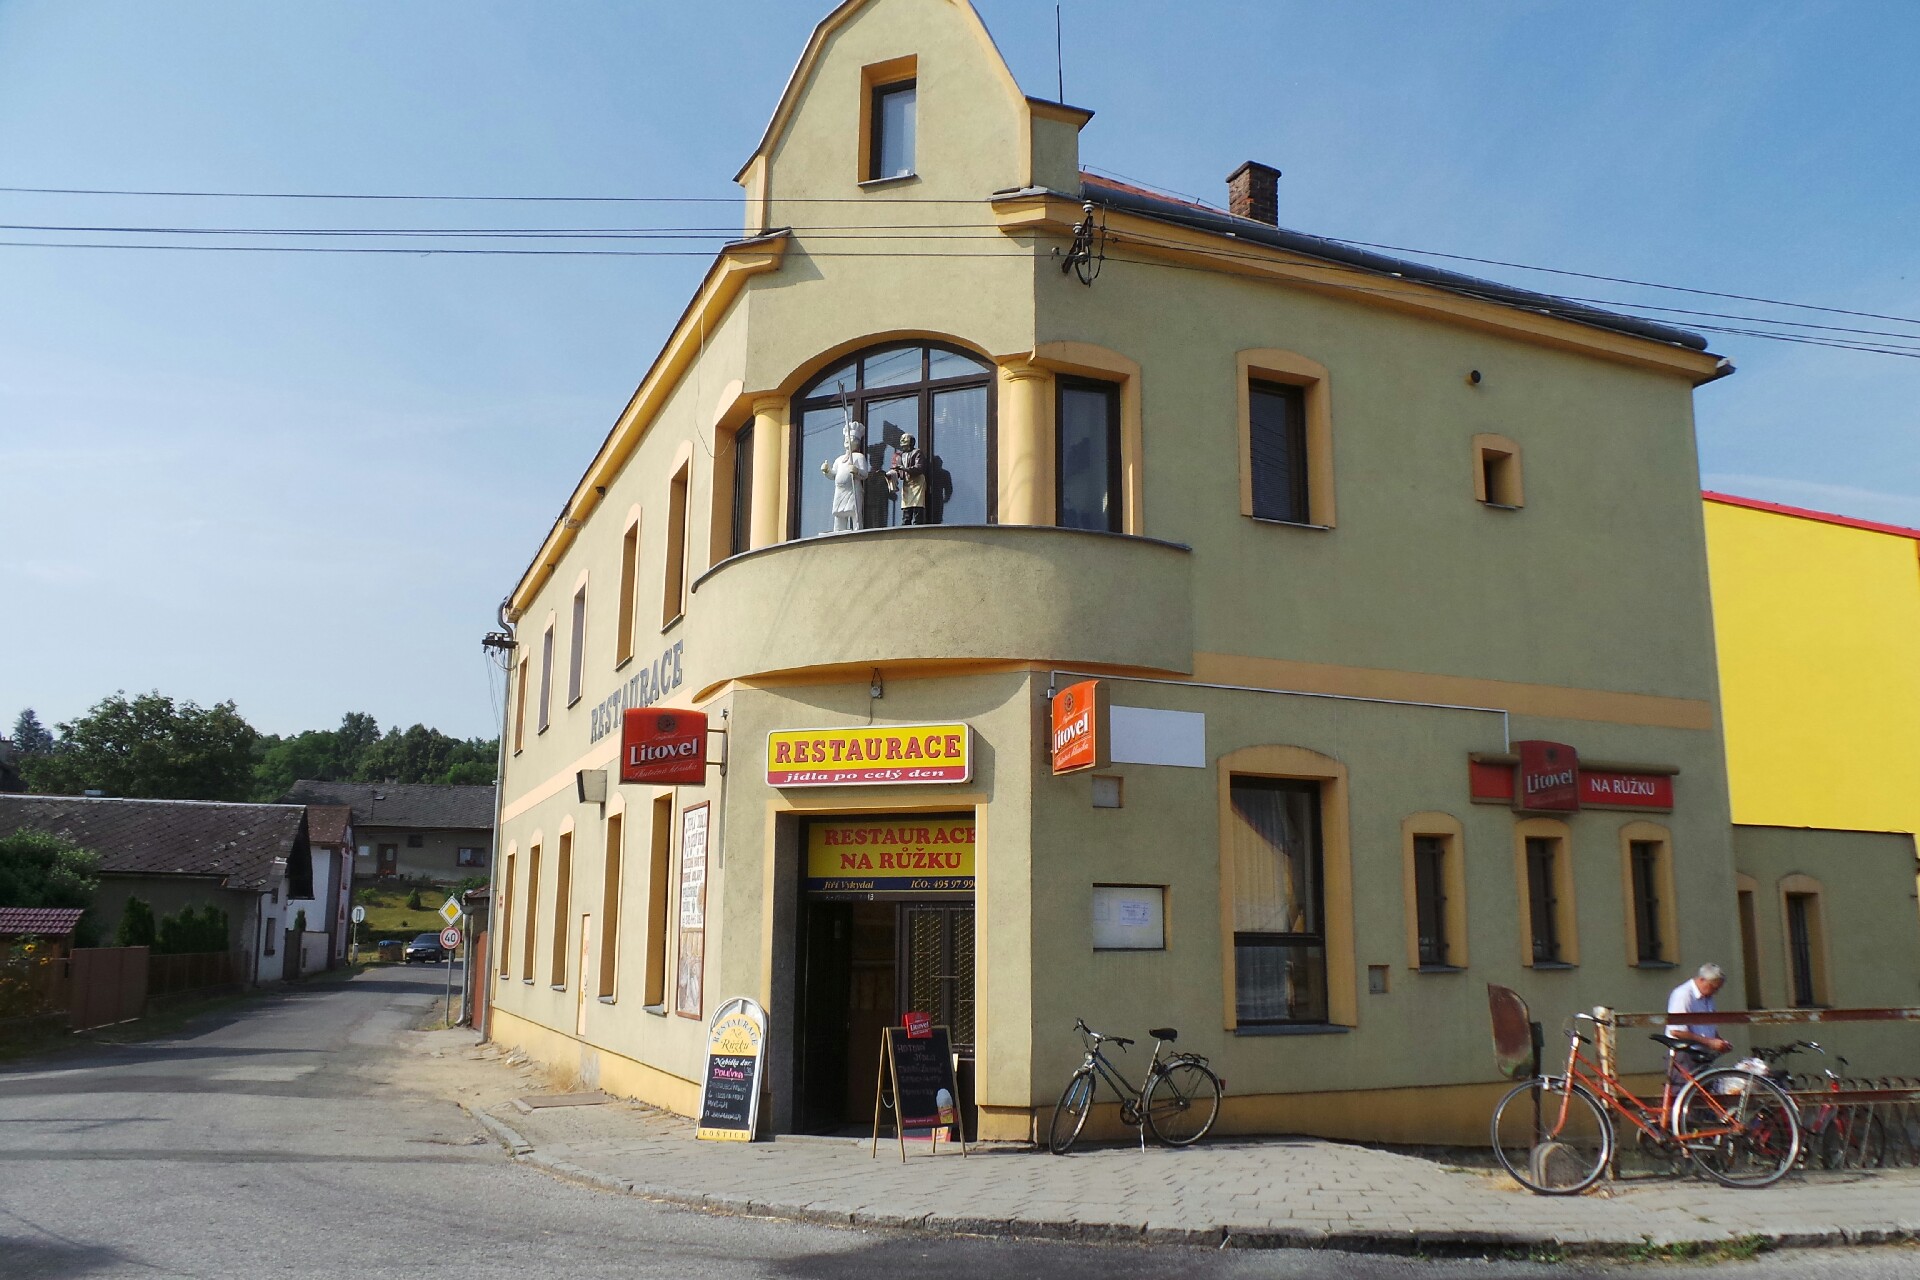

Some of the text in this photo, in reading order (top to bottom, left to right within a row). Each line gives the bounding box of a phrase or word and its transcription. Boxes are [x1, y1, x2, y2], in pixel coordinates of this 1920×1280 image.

[590, 639, 684, 744] RESTAURACE
[1054, 712, 1089, 754] Litovel
[630, 737, 698, 766] Litovel
[775, 734, 961, 764] RESTAURACE
[784, 769, 945, 783] jídla po celý den
[1526, 769, 1574, 794] Litovel
[1591, 776, 1656, 796] NA RŮŽKU
[840, 847, 962, 870] NA RŮŽKU
[933, 879, 949, 889] 495
[950, 879, 962, 889] 97
[444, 932, 456, 943] 40
